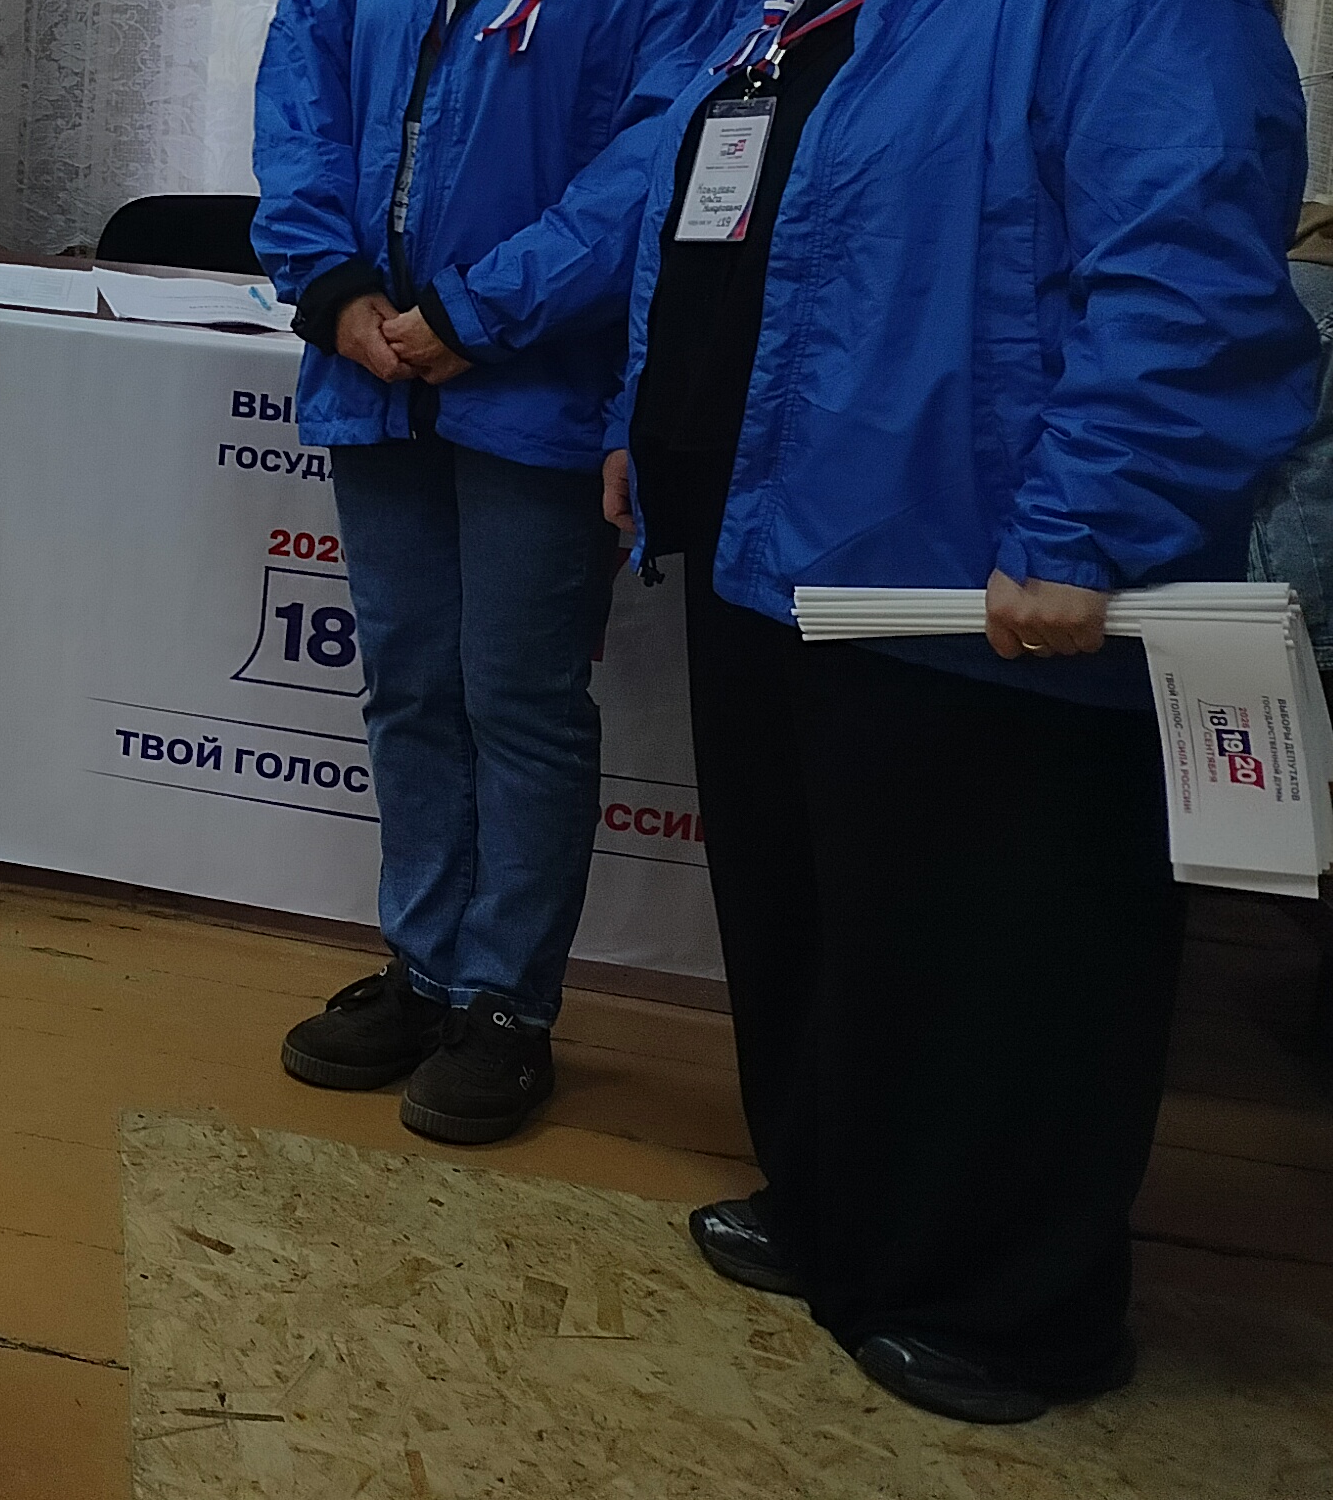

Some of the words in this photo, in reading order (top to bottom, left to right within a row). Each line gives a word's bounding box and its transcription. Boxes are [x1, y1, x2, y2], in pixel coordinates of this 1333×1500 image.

[218, 443, 333, 482] ГОСУД
[268, 529, 347, 563] 202
[275, 602, 357, 668] 18
[1165, 672, 1179, 697] ТВОЙ
[1170, 698, 1184, 729] ГОЛОС
[1277, 698, 1293, 741] ВЫБОРЫ
[115, 728, 222, 771] ТВОЙ
[234, 747, 370, 793] ГОЛОС
[1177, 740, 1189, 767] СИЛА
[1204, 732, 1218, 783] СЕНТЯБРЯ
[1208, 708, 1229, 726] 18
[1222, 732, 1244, 753] 19
[1234, 756, 1257, 784] 20
[1284, 742, 1301, 802] ДЕПУТАТОВ
[601, 803, 705, 842] ССИ
